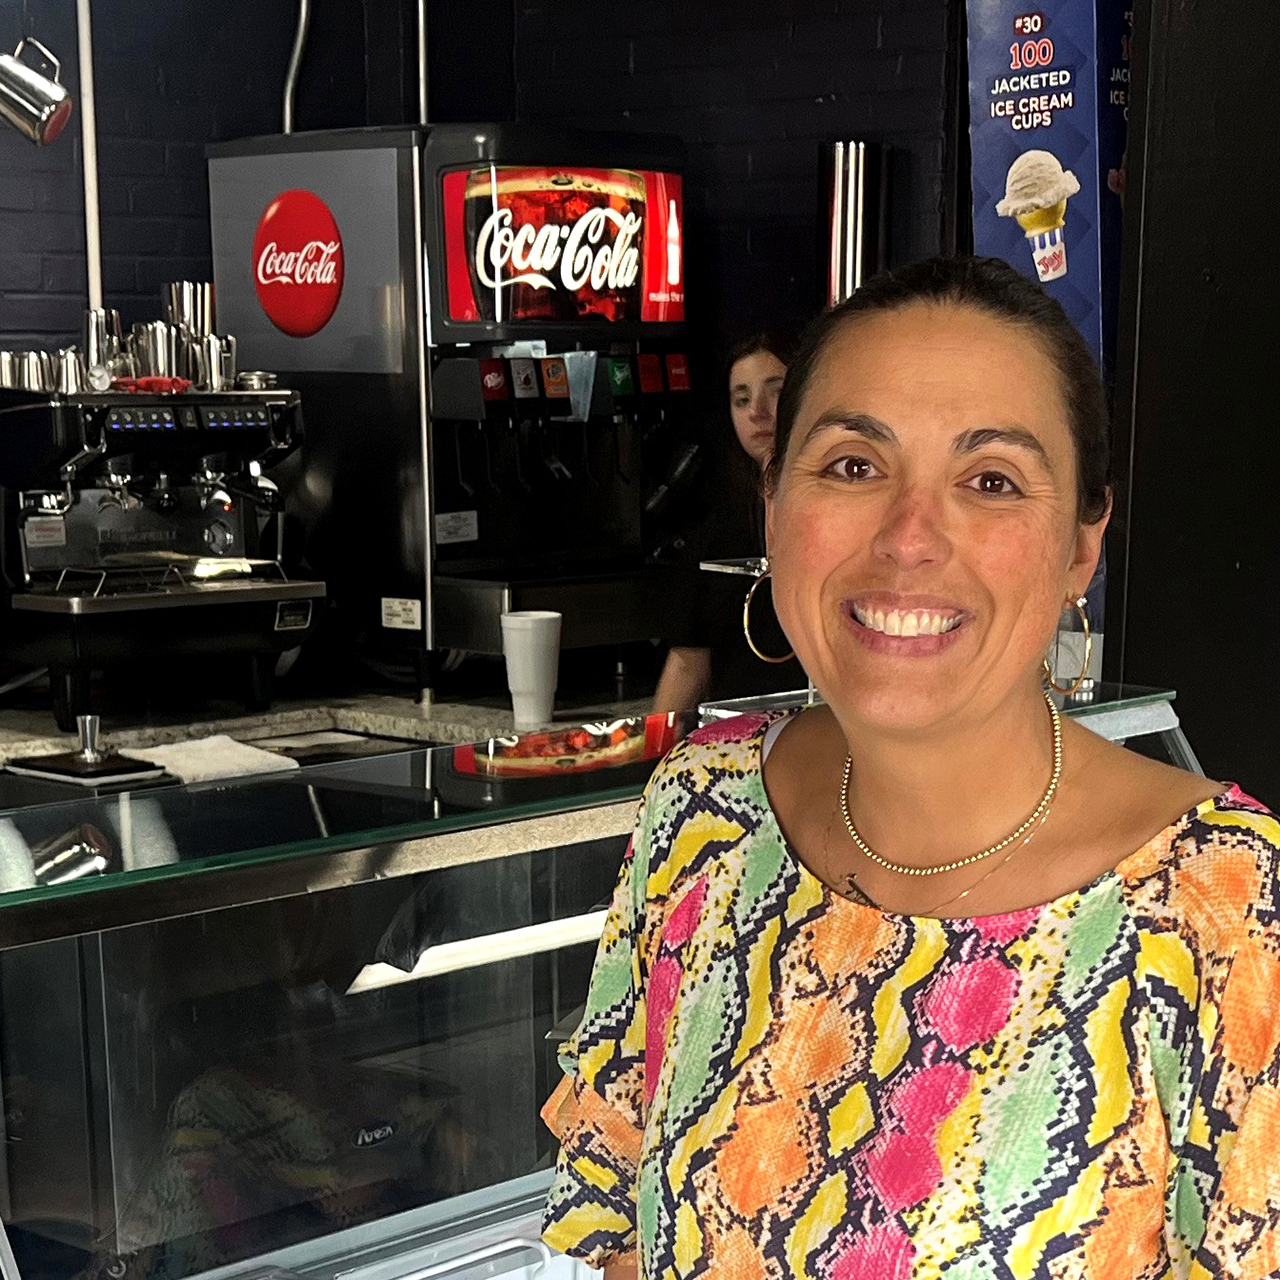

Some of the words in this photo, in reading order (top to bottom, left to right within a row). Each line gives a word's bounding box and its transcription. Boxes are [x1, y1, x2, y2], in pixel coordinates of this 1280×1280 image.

[1015, 15, 1041, 33] #30
[1010, 38, 1053, 70] 100
[991, 70, 1071, 94] JACKETED
[990, 99, 1015, 118] ICE
[1019, 91, 1073, 114] CREAM
[1011, 111, 1052, 130] CUPS
[257, 240, 340, 285] Coca-Cola
[476, 207, 642, 291] Coca-Cola
